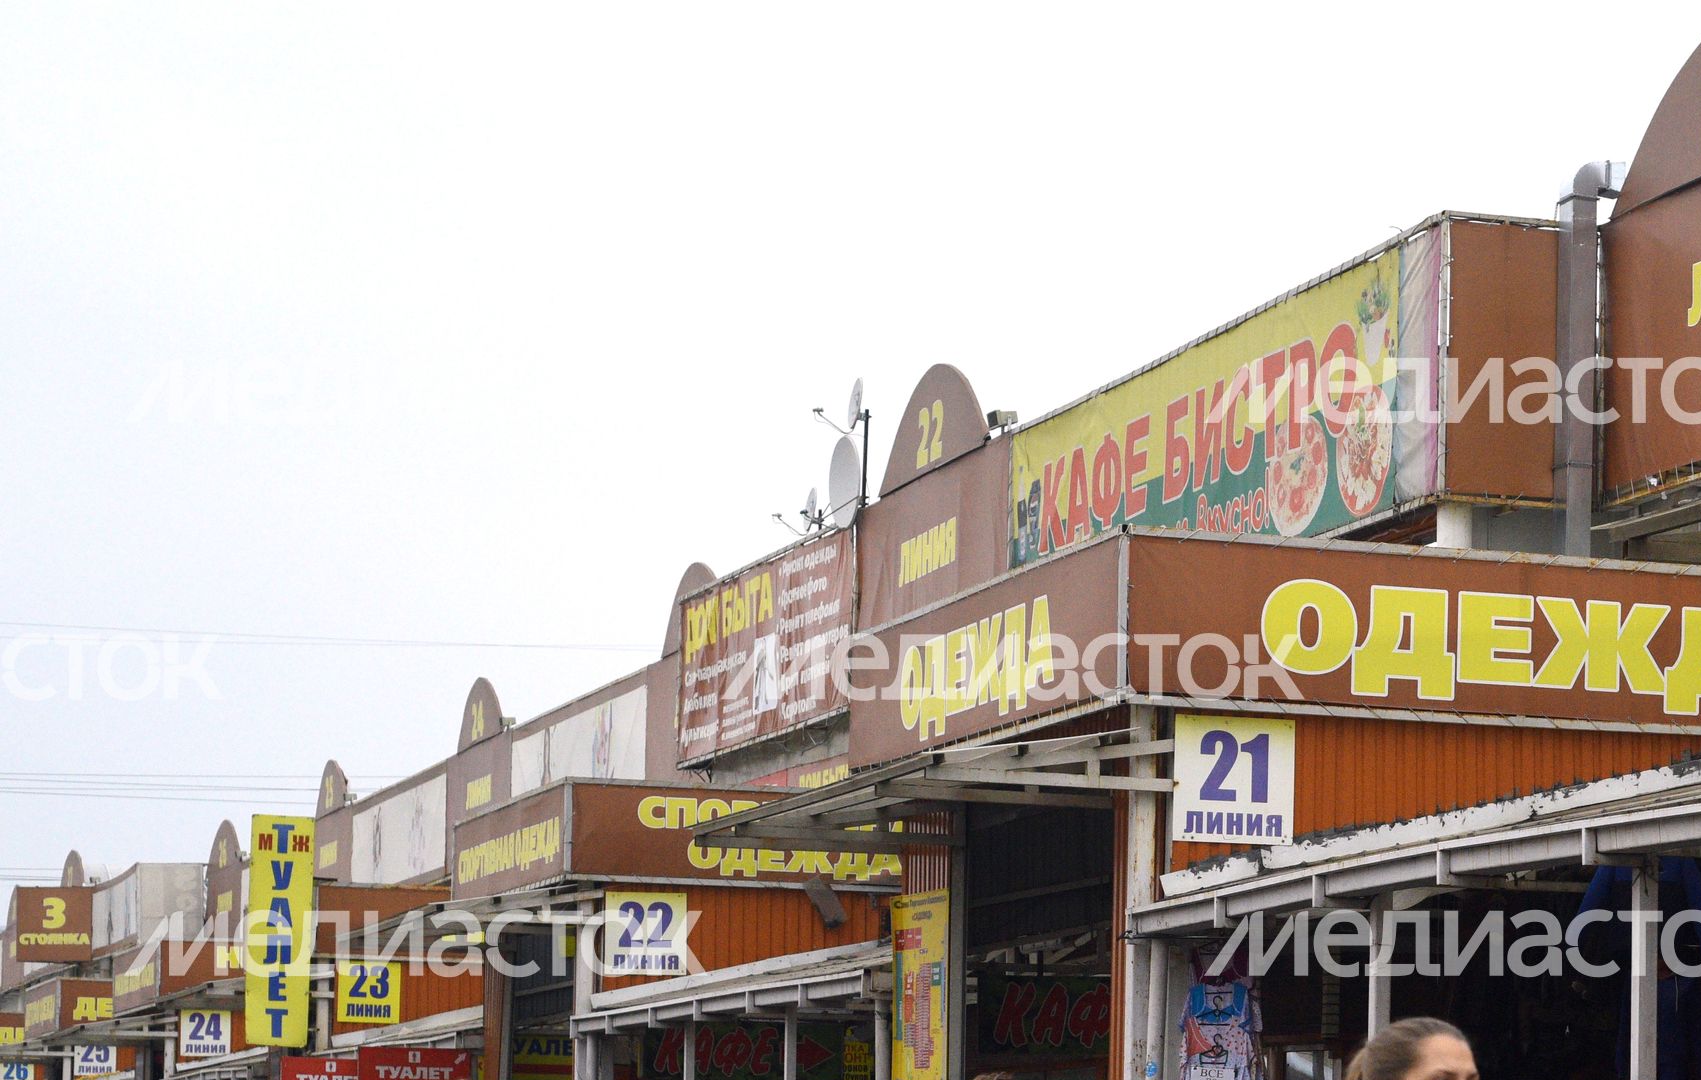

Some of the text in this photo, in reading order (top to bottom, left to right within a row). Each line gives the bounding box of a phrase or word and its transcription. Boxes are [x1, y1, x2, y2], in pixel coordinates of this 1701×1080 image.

[915, 400, 945, 470] 22
[1036, 322, 1358, 556] КАФЕ БИСТРО
[899, 516, 958, 588] ЛИНИЯ
[722, 571, 774, 638] БЫТА
[899, 595, 1055, 742] ОДЕЖДА
[1199, 729, 1269, 804] 21
[1183, 810, 1283, 838] ЛИНИЯ
[42, 897, 66, 929] 3
[618, 901, 673, 948] 22
[19, 932, 91, 945] СТОЯНКА
[264, 823, 295, 1038] ТУАЛЕТ
[612, 952, 680, 971] ЛИНИЯ
[348, 964, 390, 999] 23
[188, 1012, 222, 1041] 24
[345, 1003, 392, 1018] ЛИНИЯ
[993, 980, 1111, 1048] КАФ
[184, 1044, 226, 1054] ЛИНИЯ
[512, 1036, 573, 1057] УАЛЕ
[652, 1025, 779, 1078] КАФЕ
[78, 1065, 113, 1074] ЛИНИЯ
[375, 1064, 453, 1080] ТУАЛЕТ
[1200, 1068, 1224, 1079] ВСЕ
